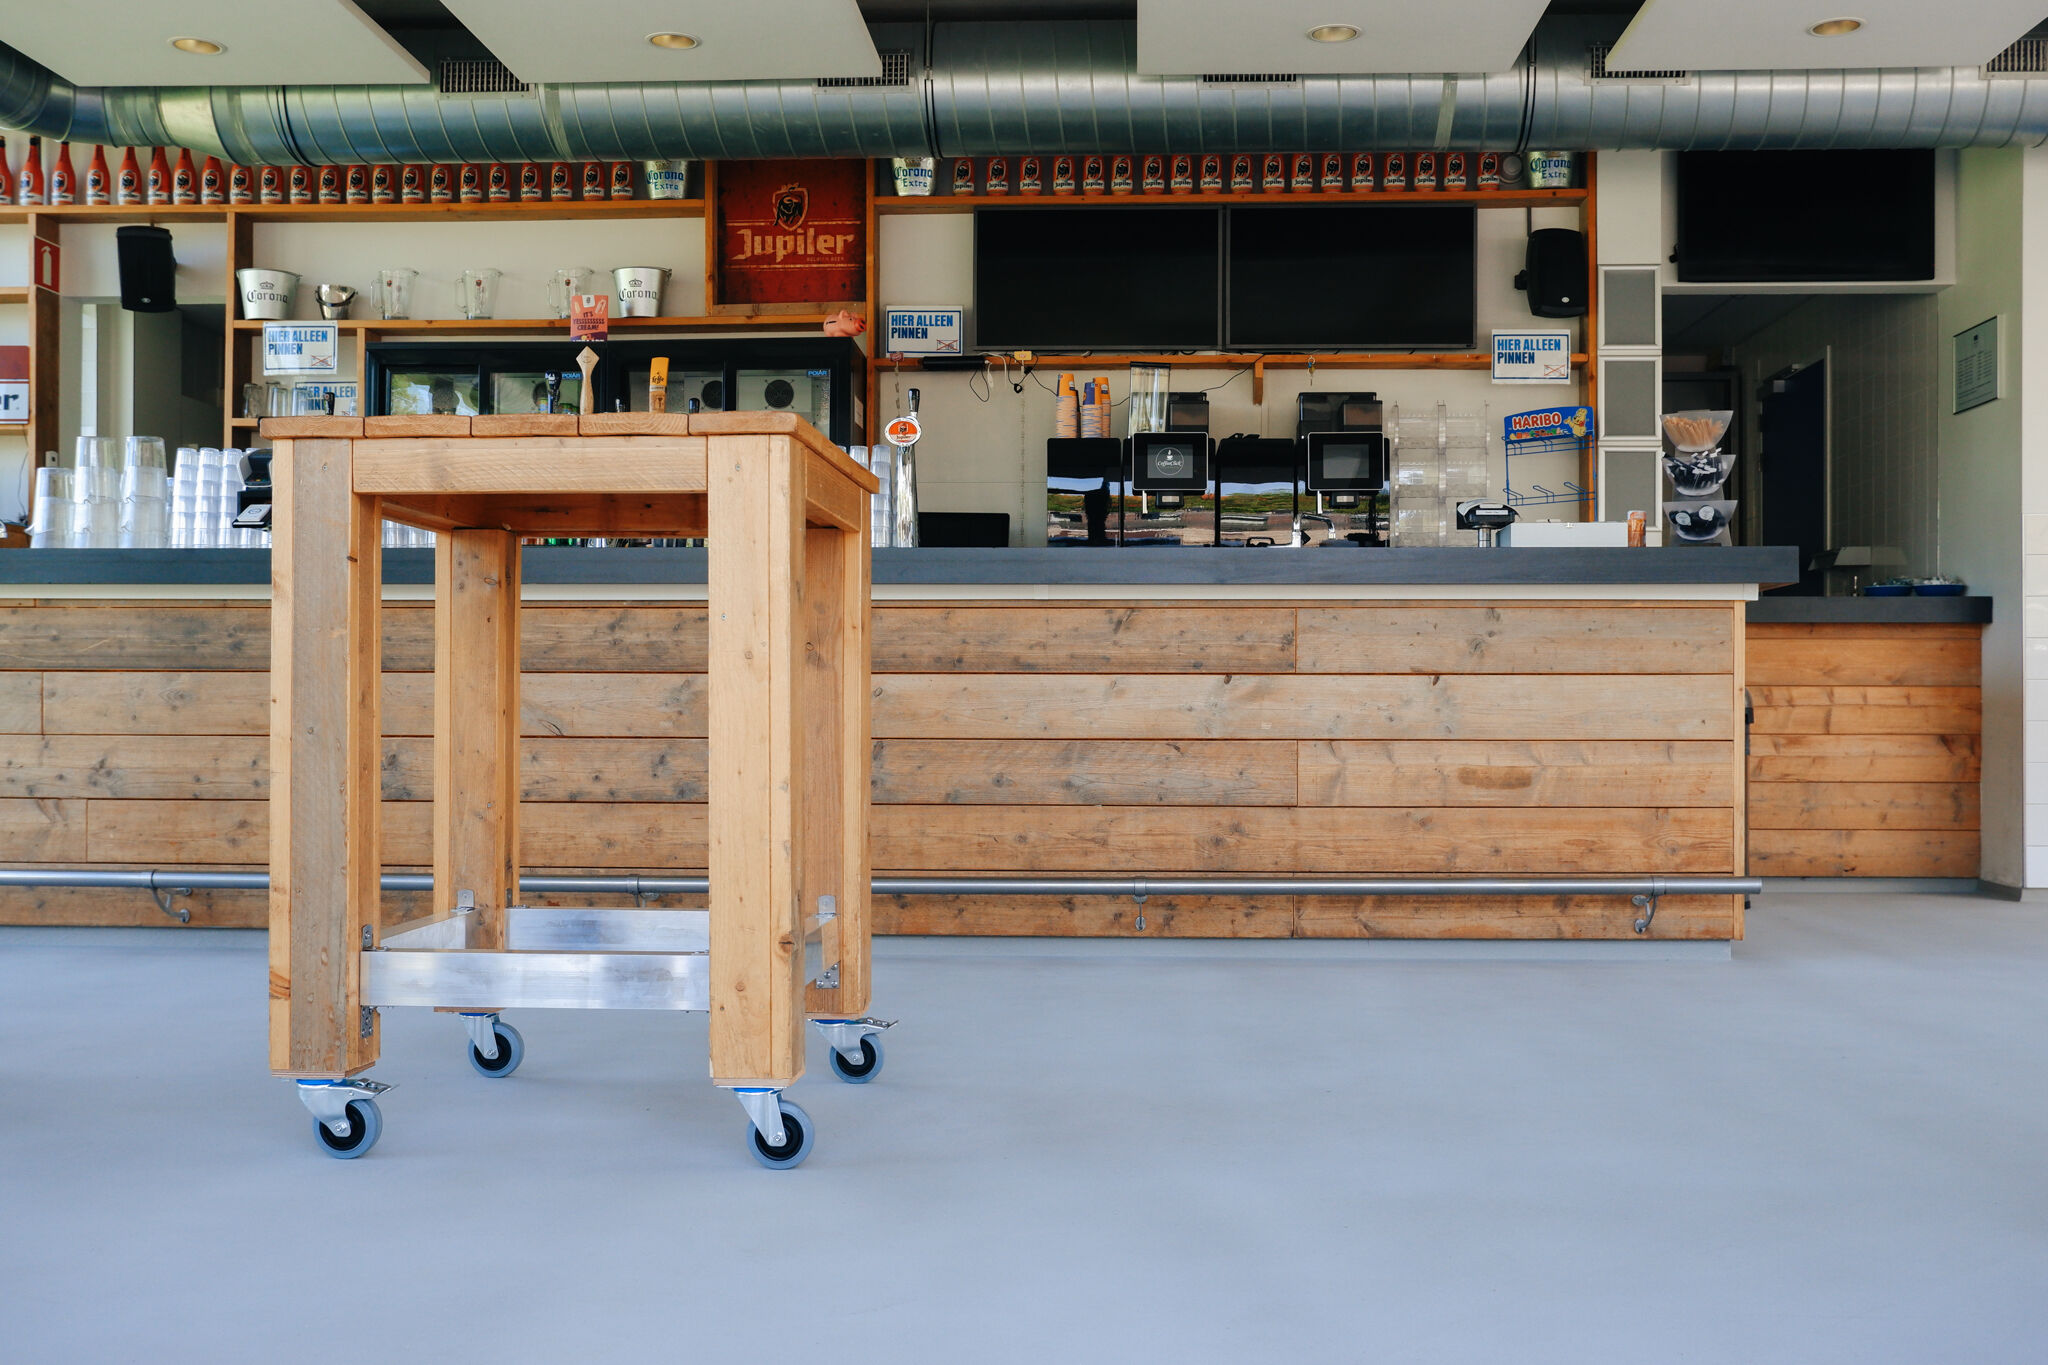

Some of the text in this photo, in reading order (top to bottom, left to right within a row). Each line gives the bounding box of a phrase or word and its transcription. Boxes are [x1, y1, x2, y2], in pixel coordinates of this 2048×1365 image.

[1530, 158, 1571, 172] Corona
[646, 170, 684, 184] Corona
[894, 166, 934, 180] Corona
[1541, 170, 1567, 179] Extra
[654, 182, 679, 191] Extra
[902, 178, 928, 188] Extra
[731, 227, 855, 263] Jupiler
[247, 289, 289, 304] Corona
[619, 288, 657, 302] Corona
[891, 314, 953, 327] HIER ALLEEN
[268, 330, 328, 343] HIER ALLEEN
[891, 327, 928, 339] PINNEN
[268, 343, 303, 355] PINNEN
[1497, 338, 1561, 351] HIER ALLEEN
[1497, 351, 1535, 364] PINNEN
[1511, 412, 1562, 430] HARIBO
